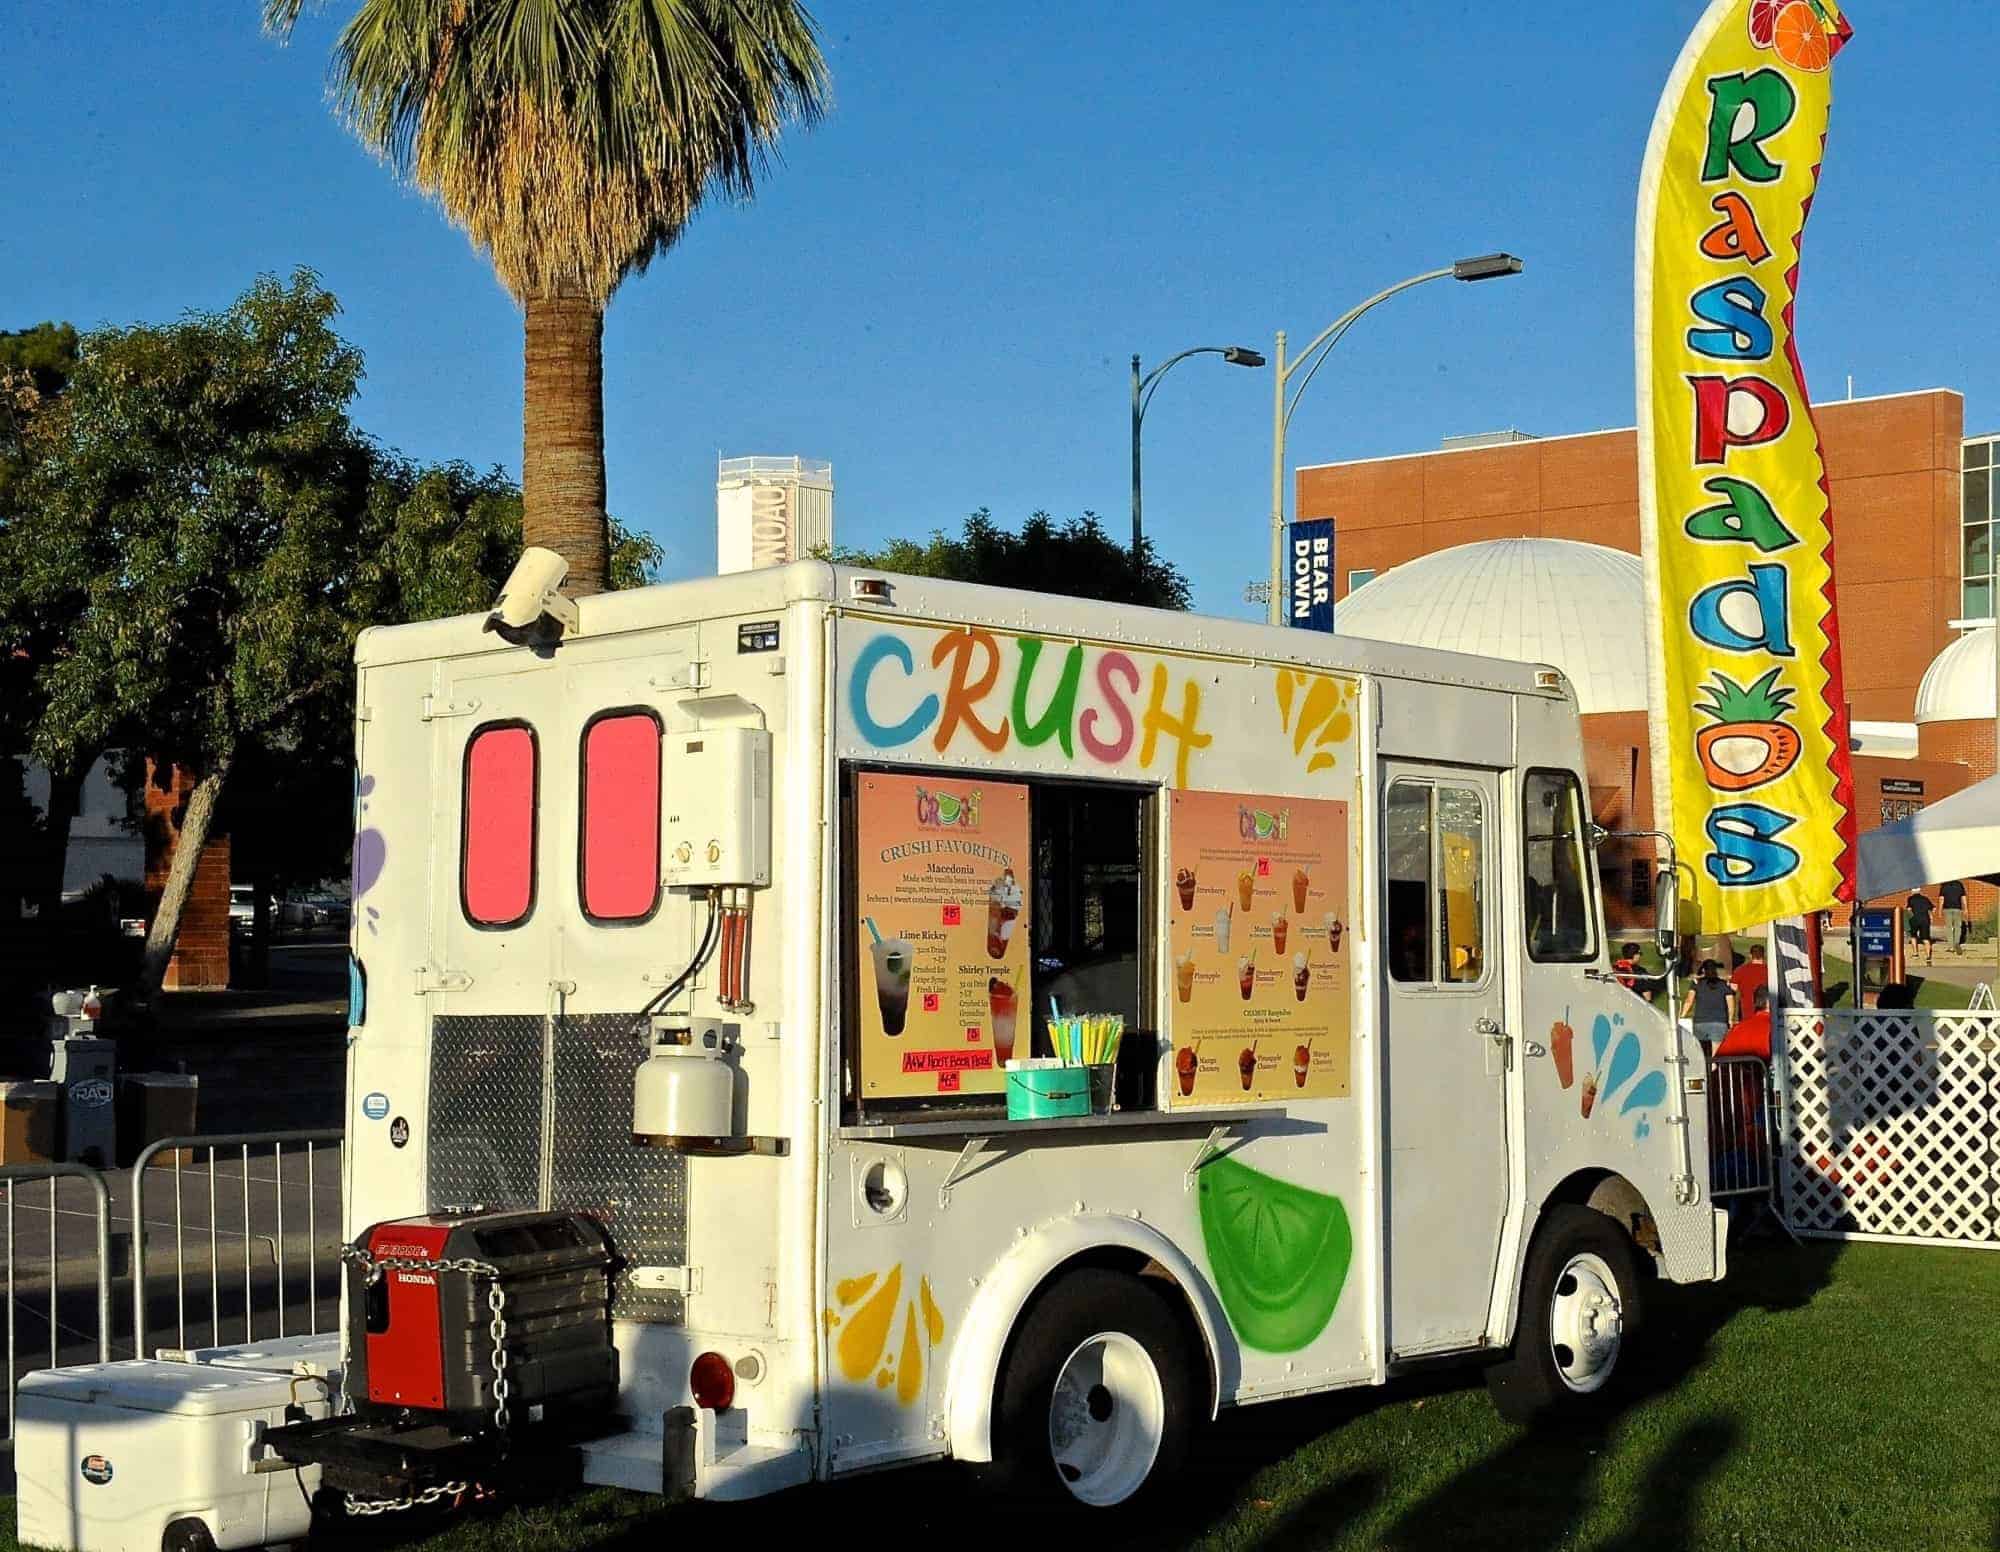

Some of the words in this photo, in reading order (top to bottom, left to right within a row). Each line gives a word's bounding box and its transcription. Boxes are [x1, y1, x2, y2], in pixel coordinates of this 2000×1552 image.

[1295, 540, 1310, 618] DOWN
[1313, 537, 1329, 606] BEAR
[848, 626, 1213, 790] CRUSH
[881, 840, 931, 863] CRUSH
[927, 864, 975, 875] Macedonia
[900, 930, 920, 940] Lime
[921, 930, 946, 942] Rickey
[959, 965, 984, 976] Shirley
[985, 966, 1011, 977] Temple
[398, 1272, 436, 1286] HONDA
